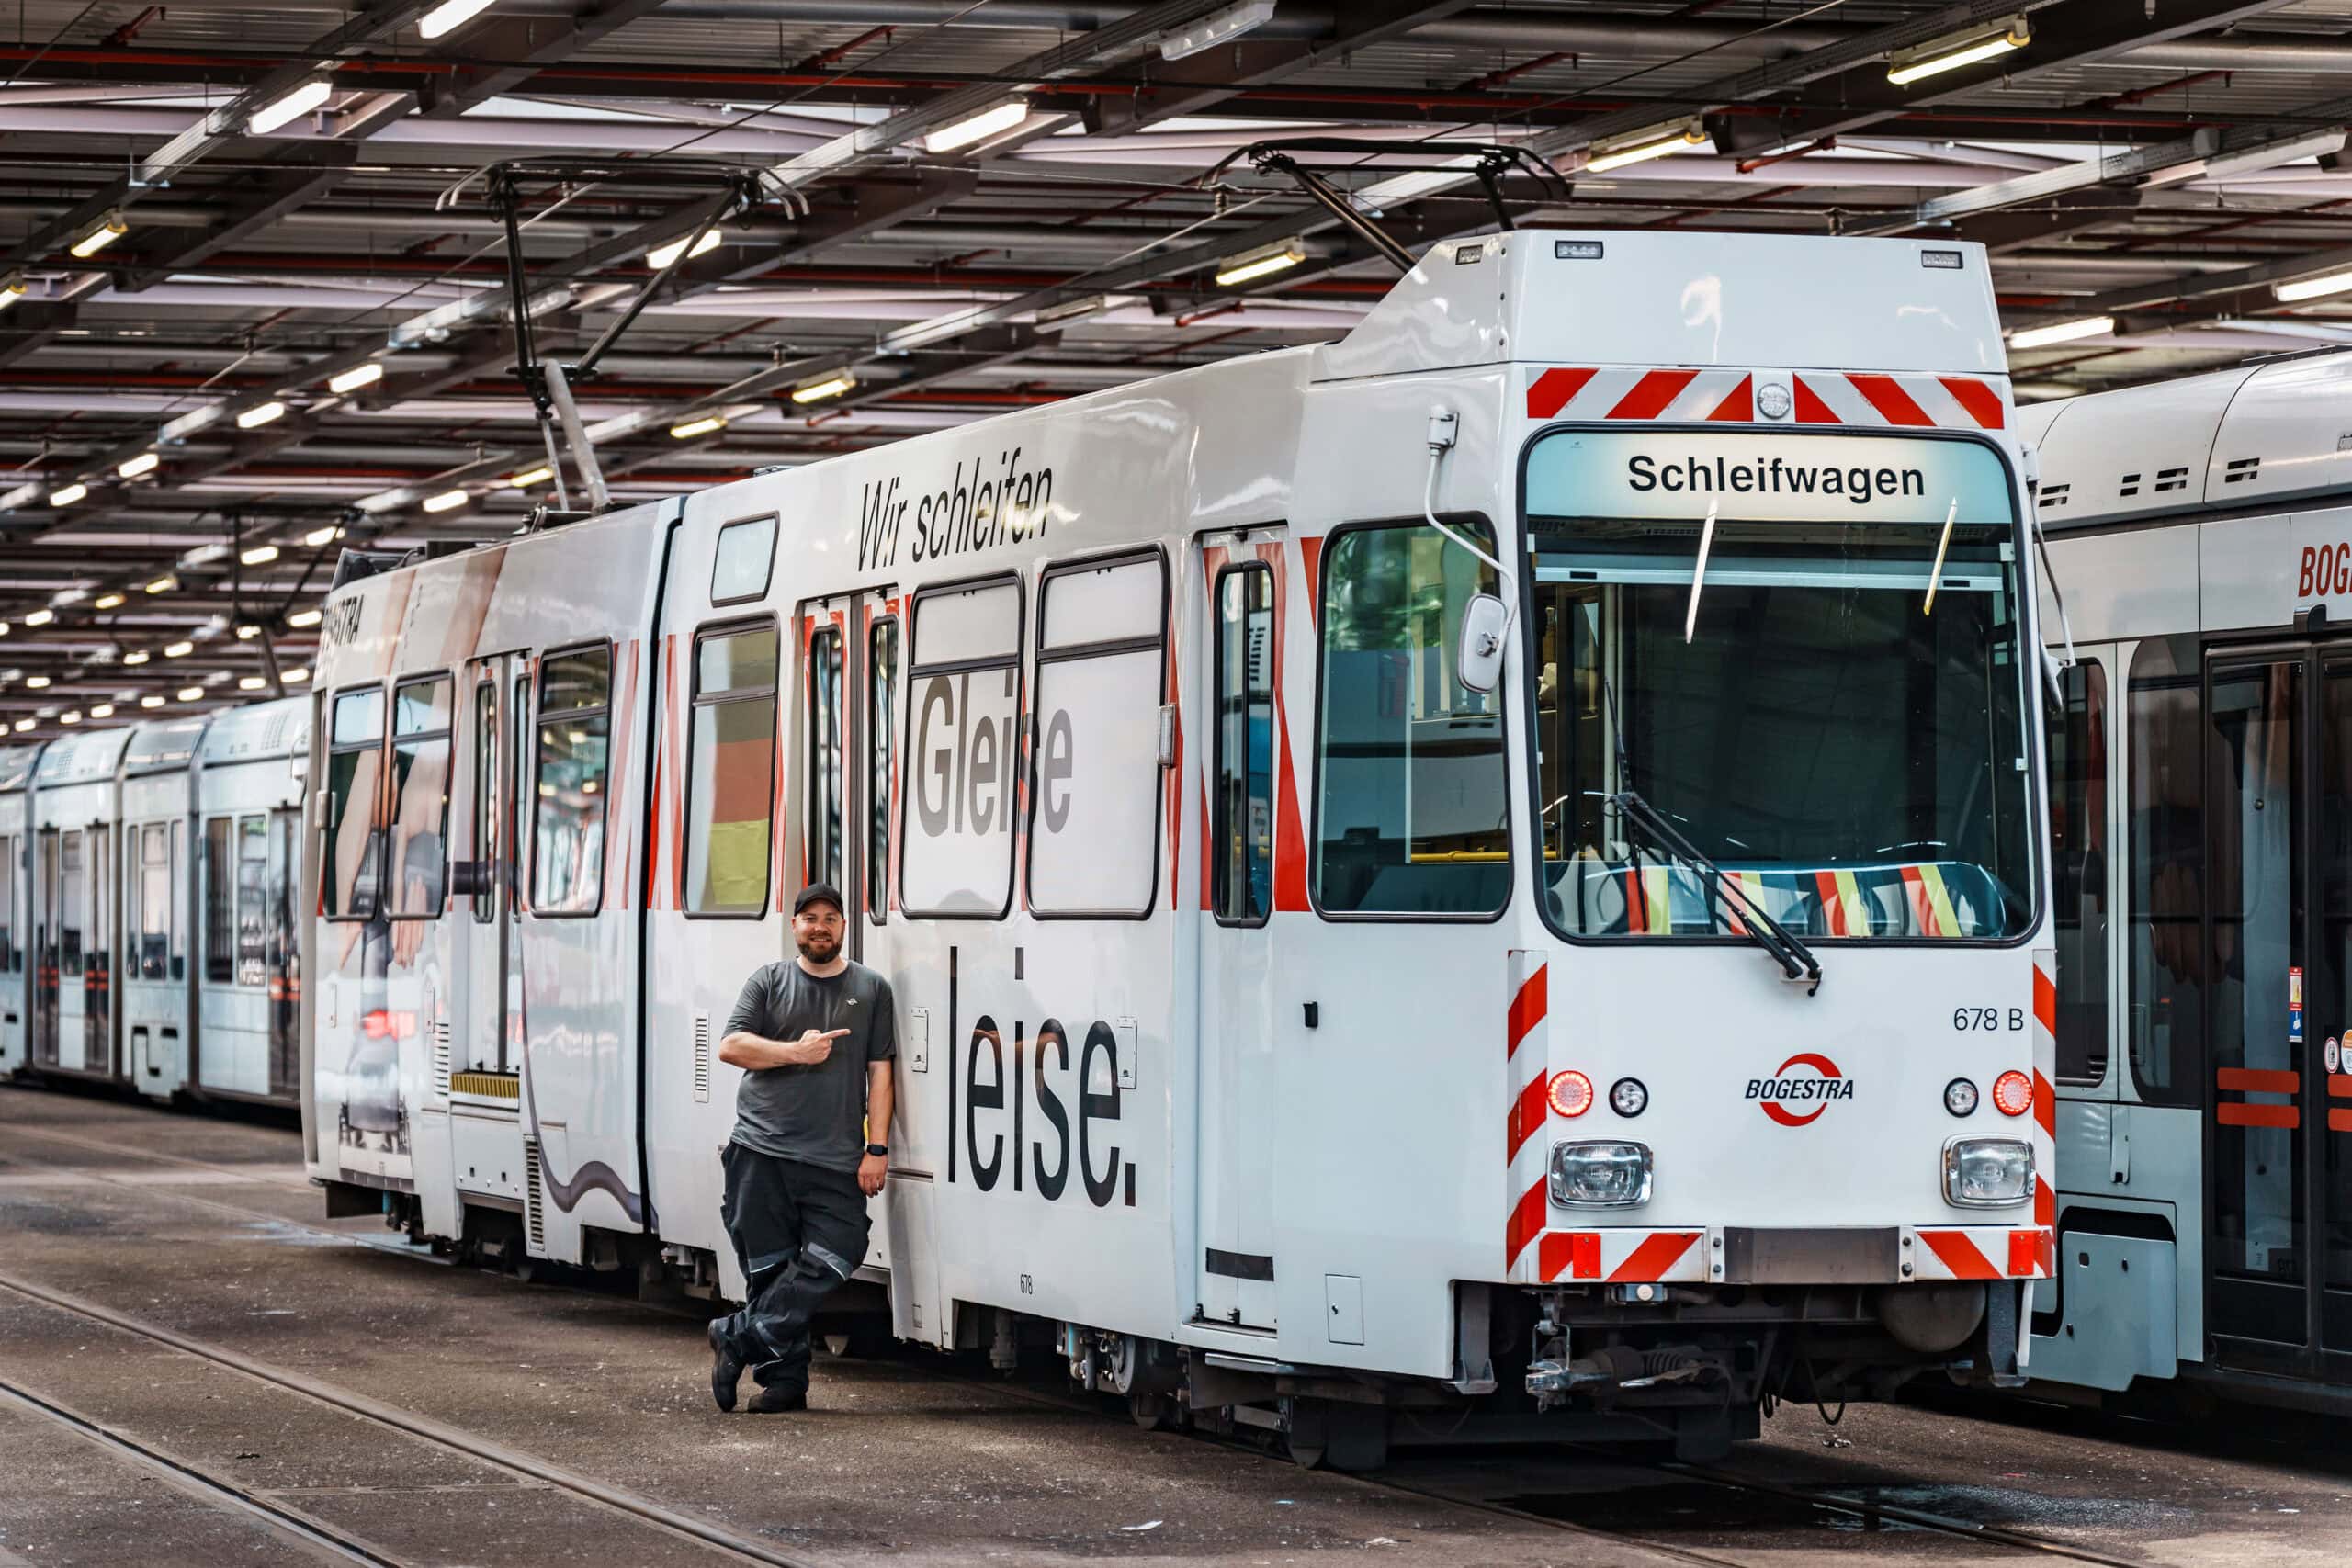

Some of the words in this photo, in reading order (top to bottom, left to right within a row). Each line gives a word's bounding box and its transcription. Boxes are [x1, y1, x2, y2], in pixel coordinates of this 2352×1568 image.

[1628, 455, 1925, 504] Schleifwagen
[858, 476, 908, 571] Wir
[912, 446, 1052, 563] schleifen
[2298, 542, 2352, 597] BOG
[1953, 1008, 1998, 1031] 678
[2008, 1008, 2024, 1031] B
[948, 946, 1136, 1208] leise.
[1745, 1079, 1854, 1100] BOGESTRA
[1020, 1273, 1033, 1295] 678
